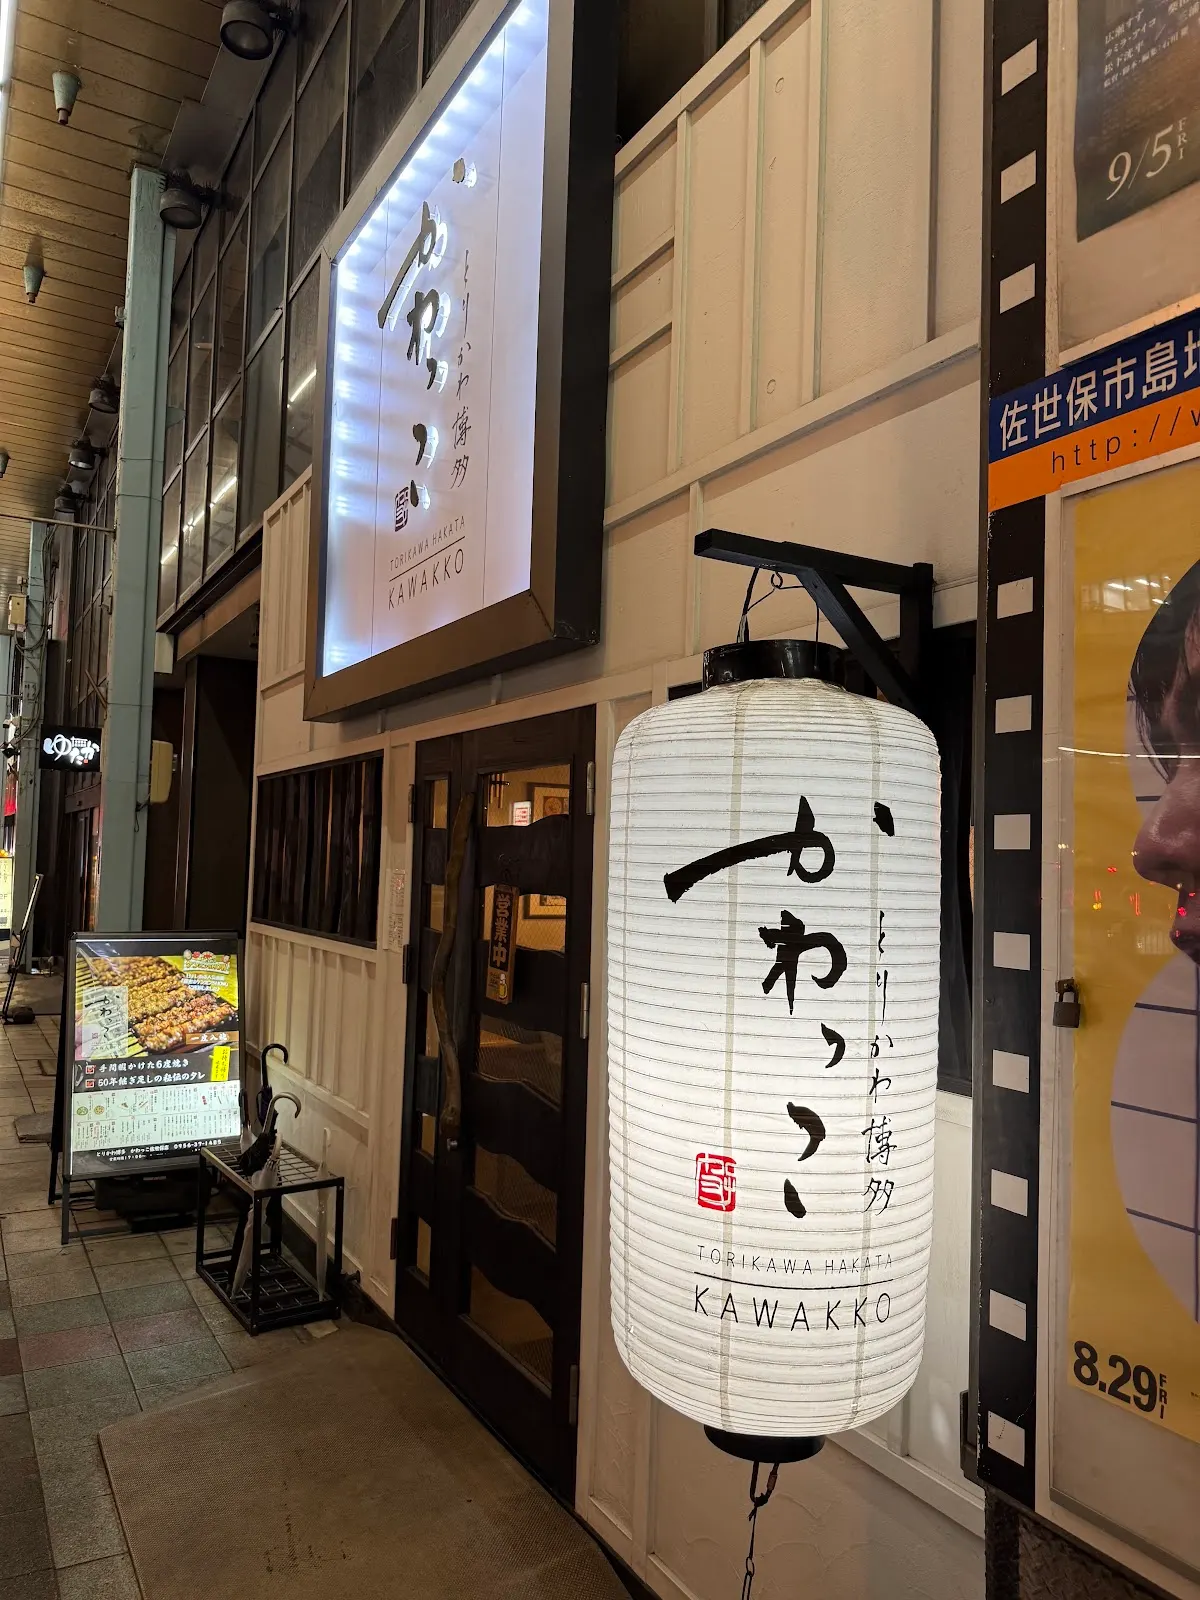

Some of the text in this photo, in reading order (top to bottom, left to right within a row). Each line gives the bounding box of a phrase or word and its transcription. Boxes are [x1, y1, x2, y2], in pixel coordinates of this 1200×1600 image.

[1107, 124, 1174, 200] 9/5
[1177, 117, 1188, 160] FRI
[389, 515, 465, 571] TORIKAWA HAKATA
[388, 548, 465, 611] KAWAKKO
[492, 893, 511, 968] 営業中
[697, 1244, 893, 1275] TORIKAWA HAKATA
[694, 1284, 891, 1332] KAWAKKO
[1073, 1340, 1168, 1419] 8.29 FRI
